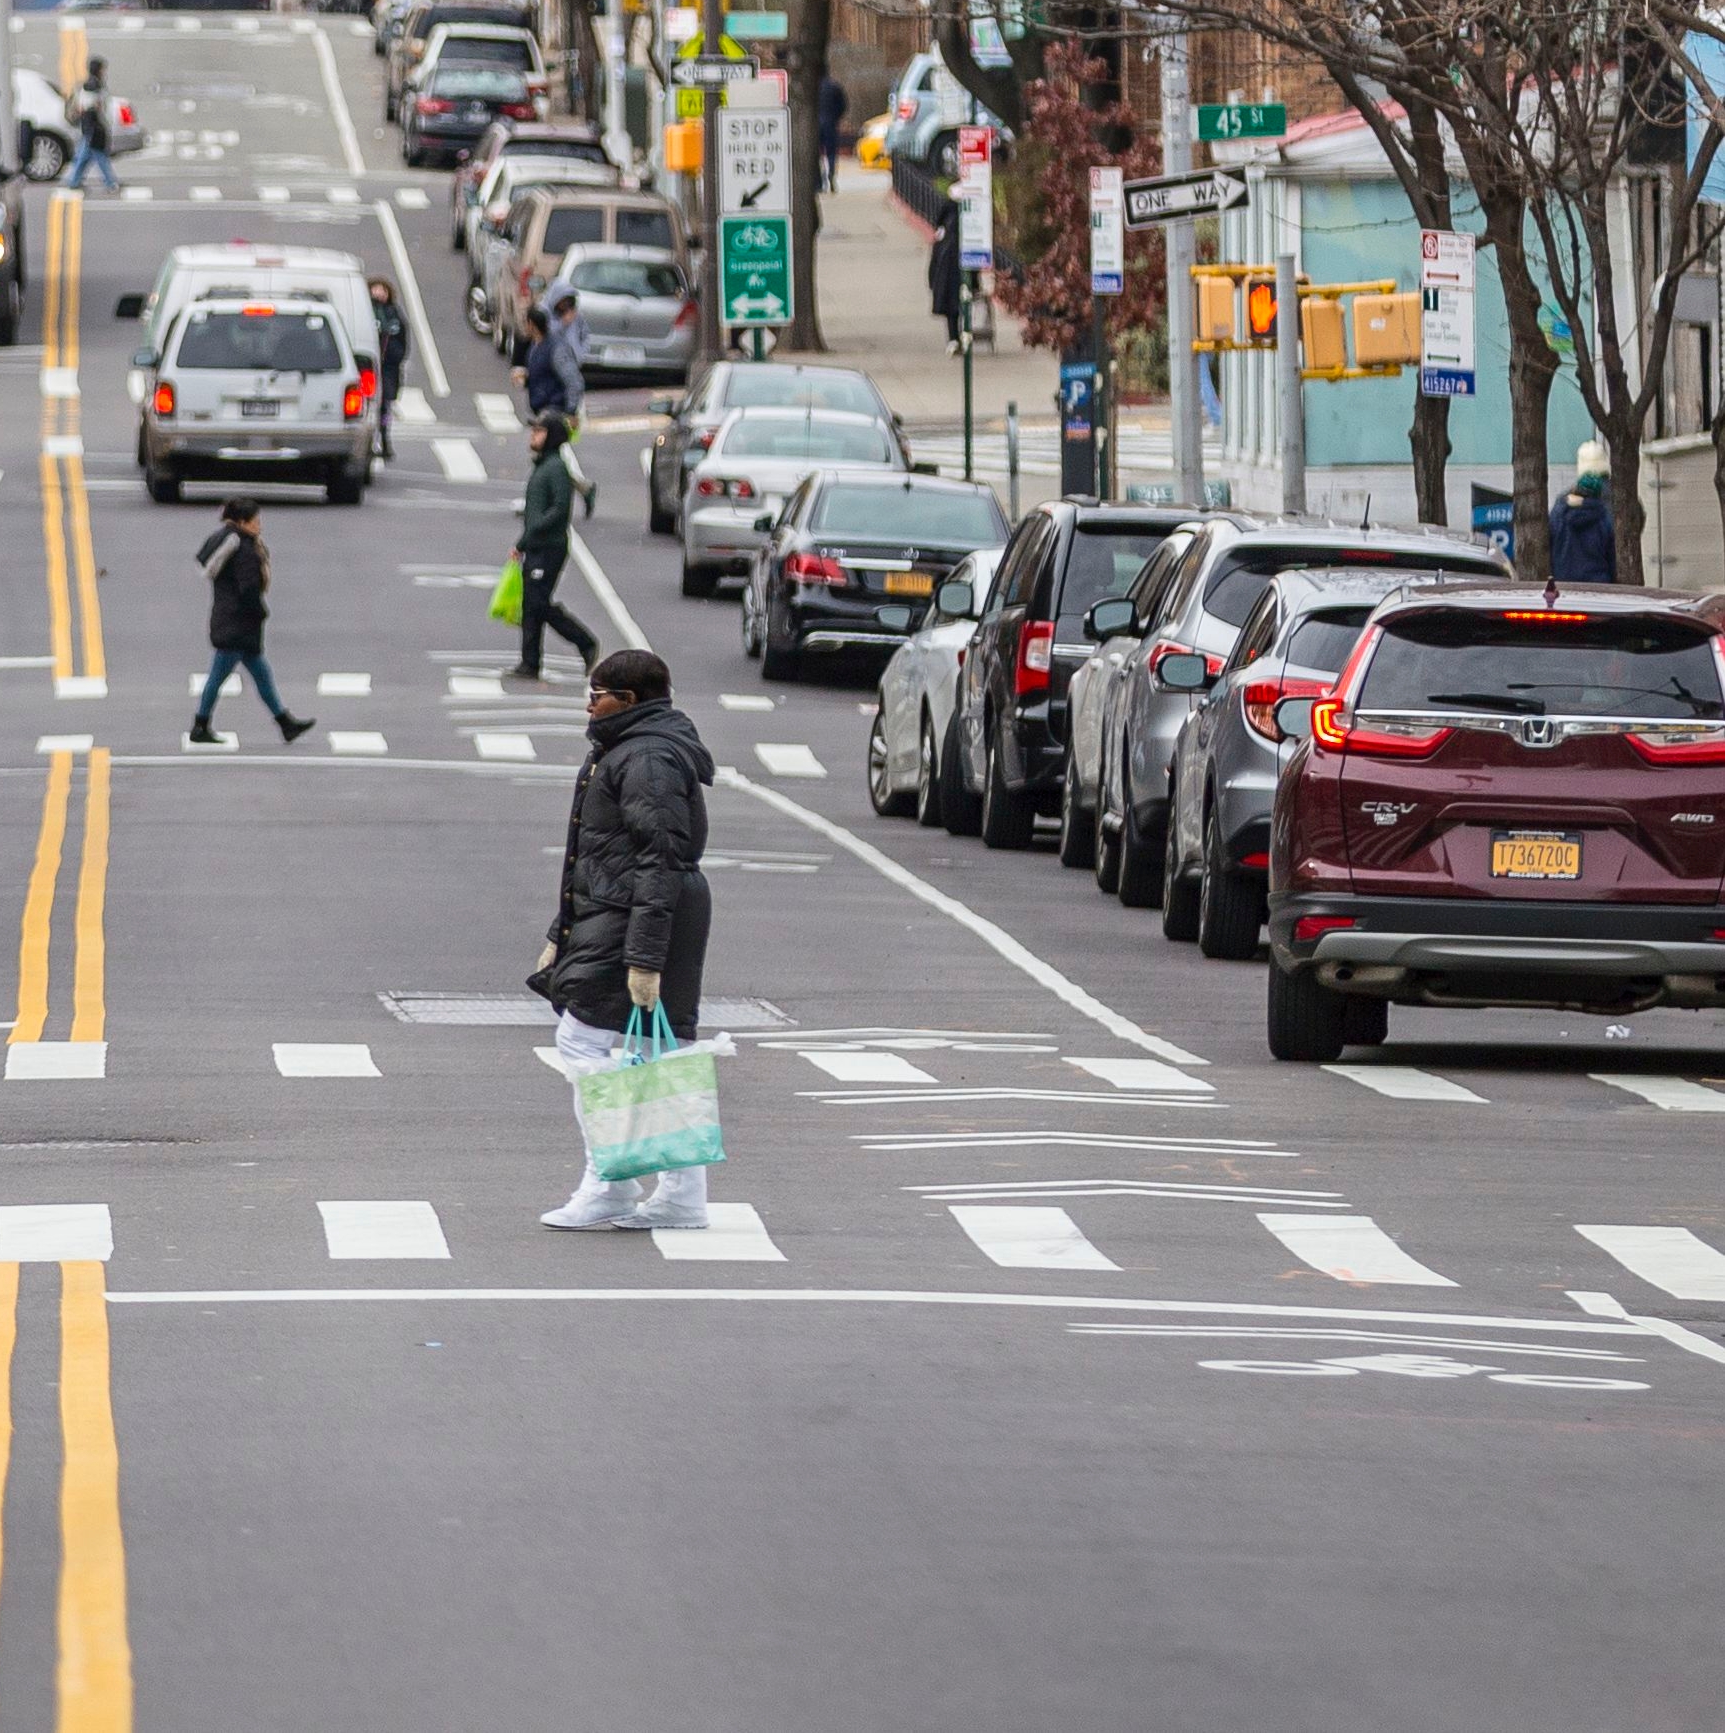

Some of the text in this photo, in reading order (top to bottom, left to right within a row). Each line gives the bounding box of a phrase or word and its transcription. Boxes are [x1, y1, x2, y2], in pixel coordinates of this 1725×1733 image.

[730, 119, 779, 137] STOP
[1216, 108, 1243, 137] 45
[728, 143, 758, 154] HERE
[735, 159, 776, 175] RED
[1136, 179, 1231, 210] ONE WAY
[1360, 801, 1418, 814] CR-V
[1670, 813, 1715, 823] AWD
[1499, 844, 1573, 867] T736720C
